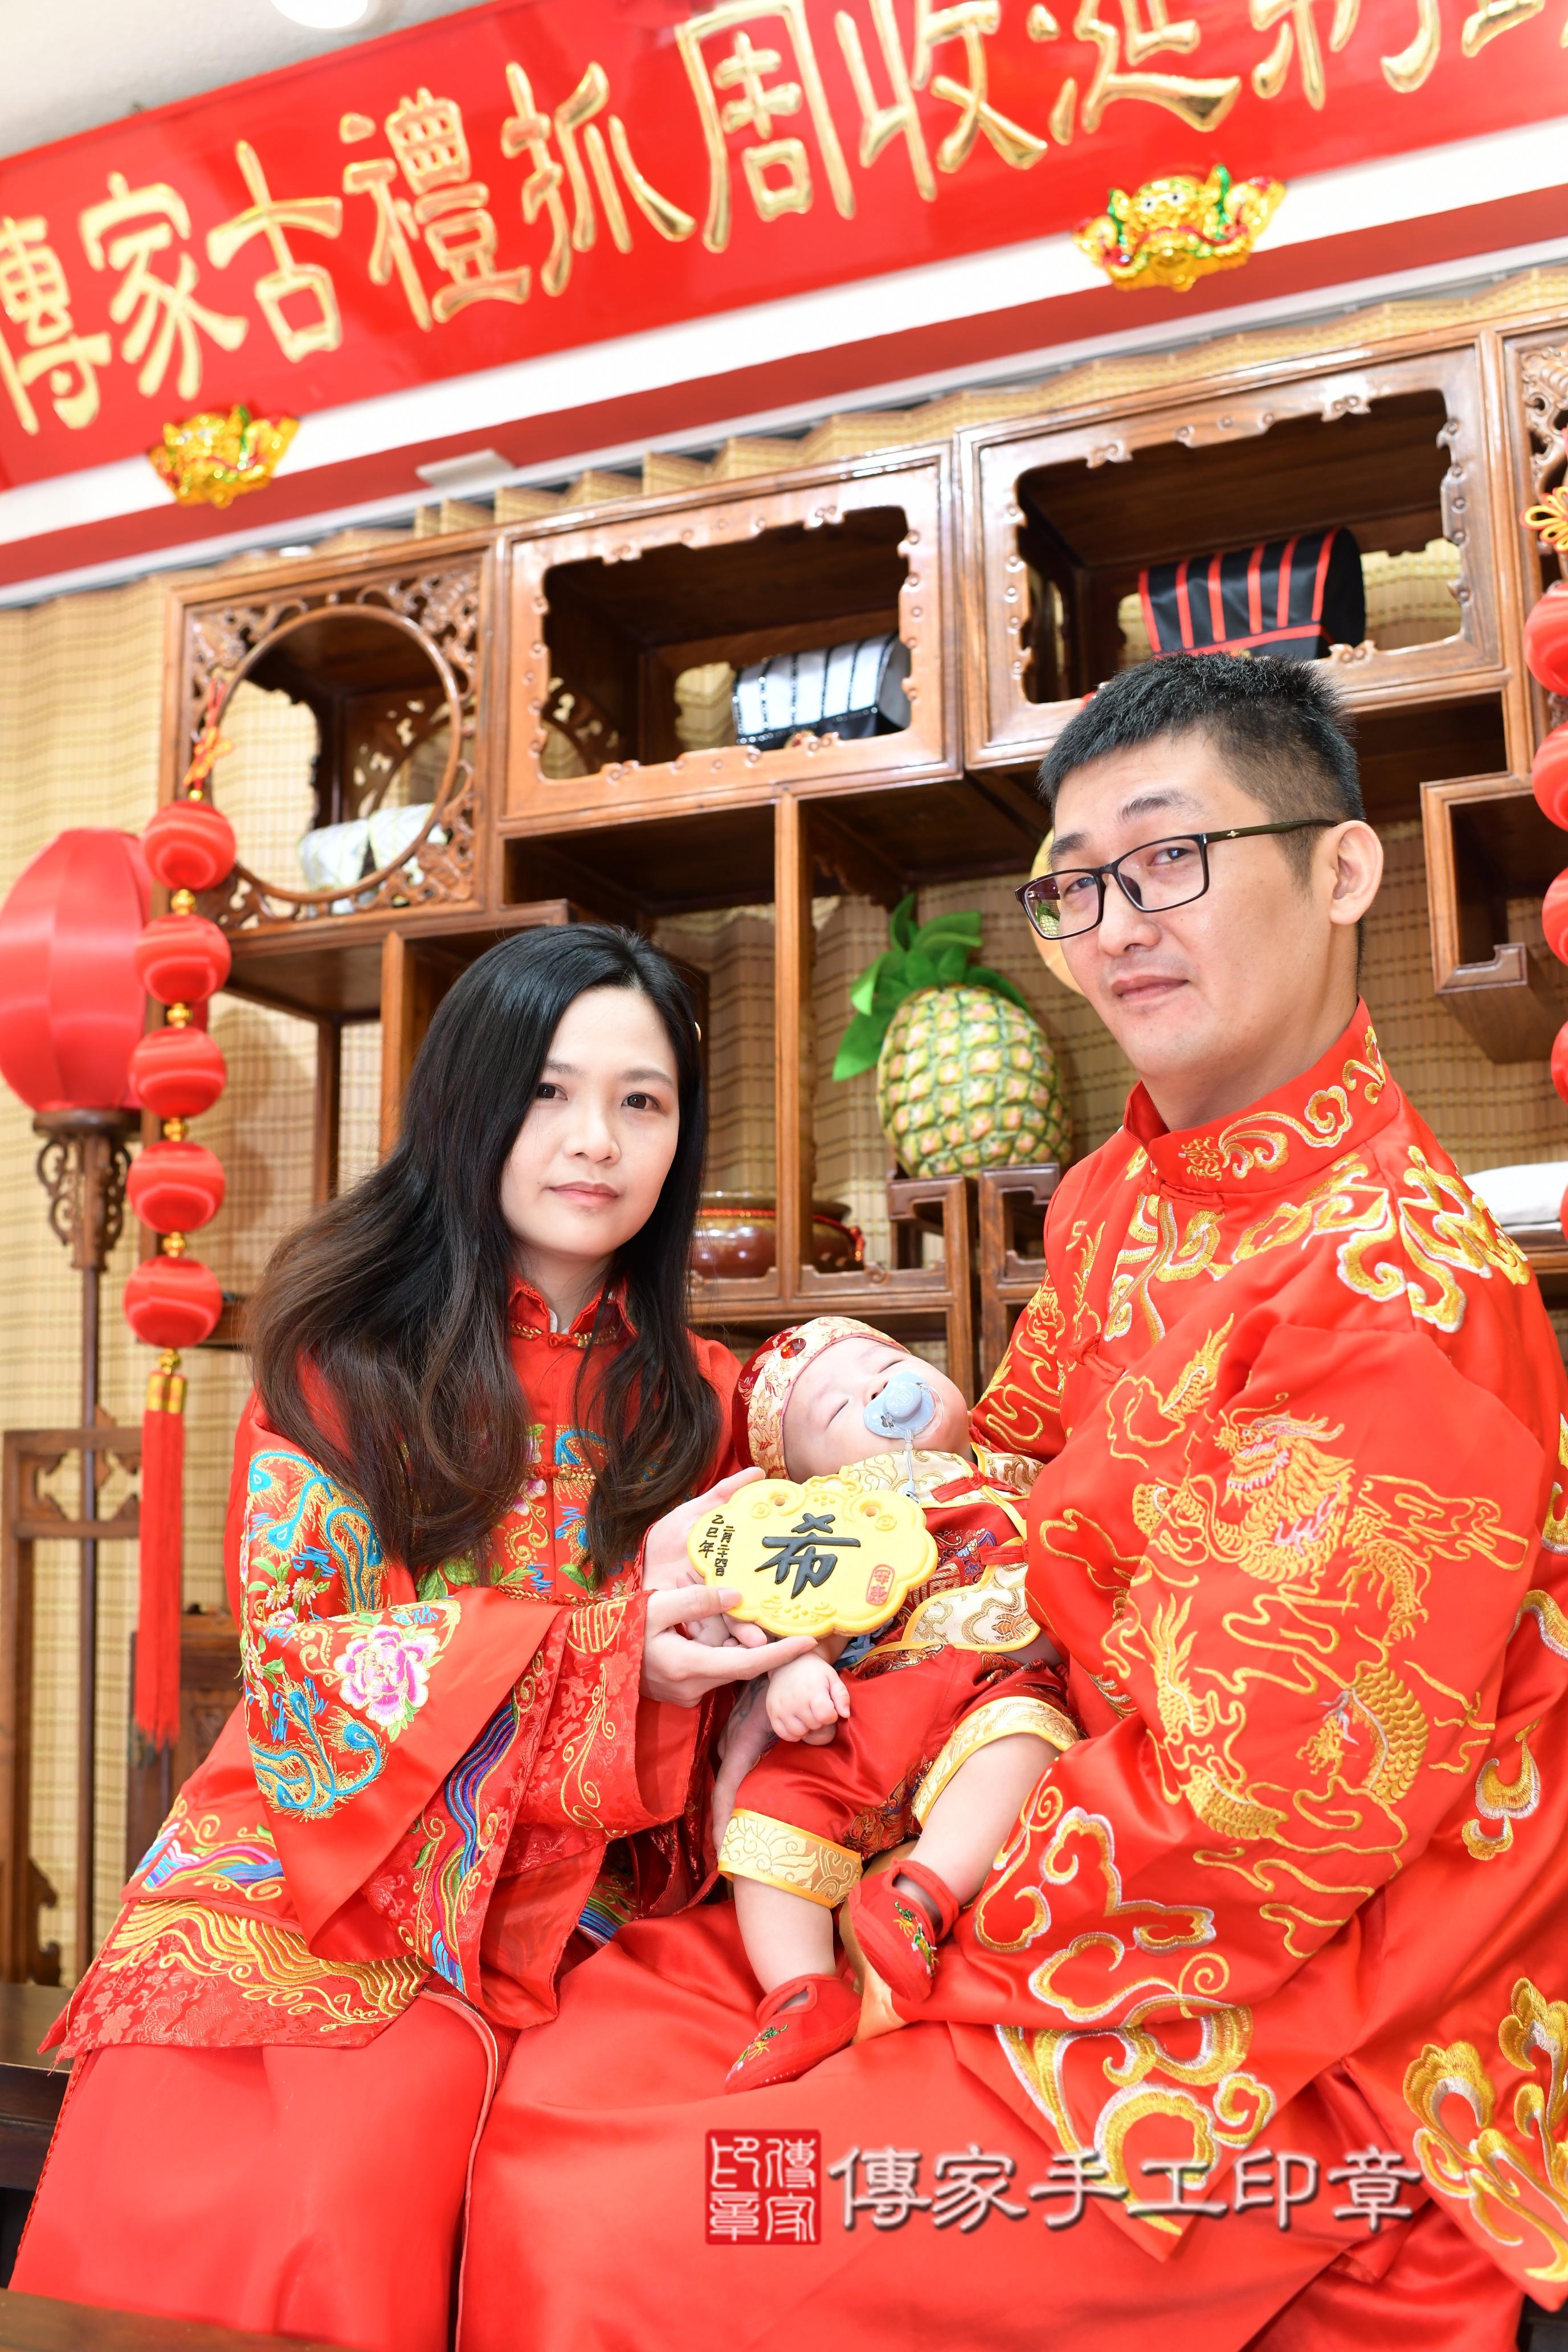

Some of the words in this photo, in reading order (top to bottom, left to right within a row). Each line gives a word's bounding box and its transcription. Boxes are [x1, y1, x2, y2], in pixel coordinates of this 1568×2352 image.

[698, 1514, 724, 1558] 乙巳年
[714, 1525, 736, 1577] 二月二十四日
[755, 1513, 860, 1599] 希
